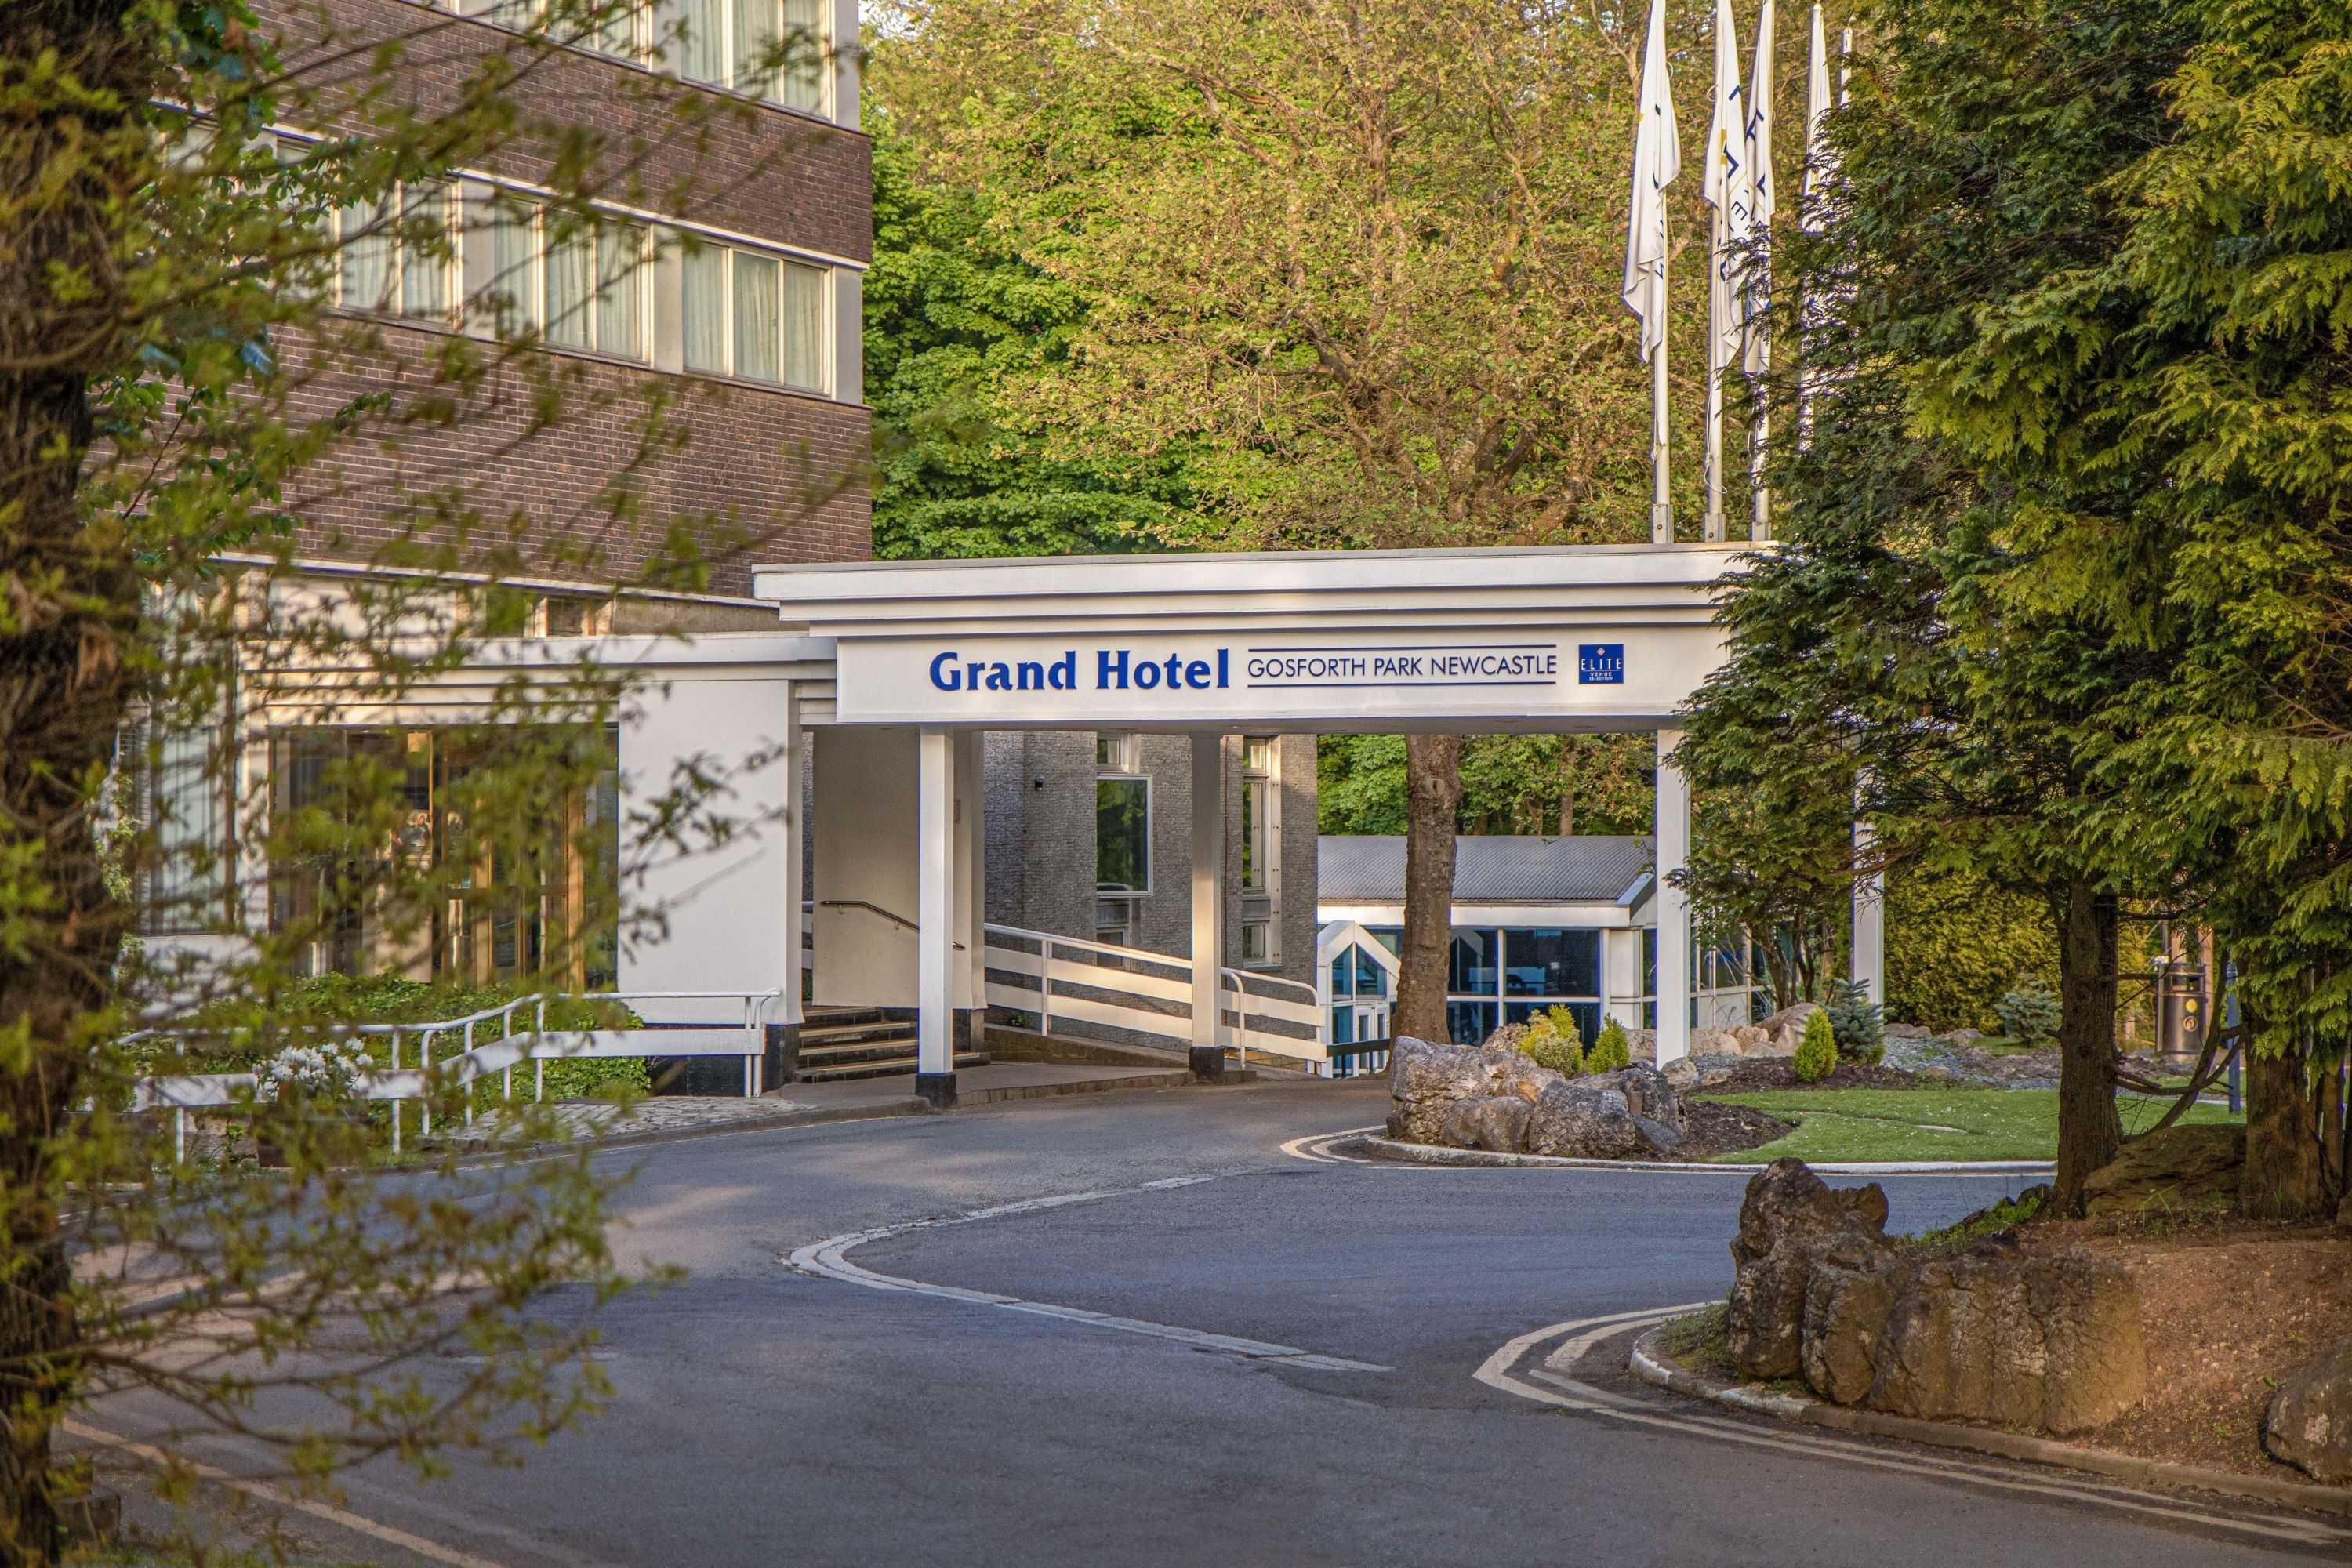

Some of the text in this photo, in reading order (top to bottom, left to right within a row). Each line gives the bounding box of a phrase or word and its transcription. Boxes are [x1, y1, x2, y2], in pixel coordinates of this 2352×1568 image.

[930, 648, 1229, 691] Grand Hotel
[1248, 655, 1557, 678] GOSFORTH PARK NEWCASTLE
[1581, 659, 1621, 670] ELITE
